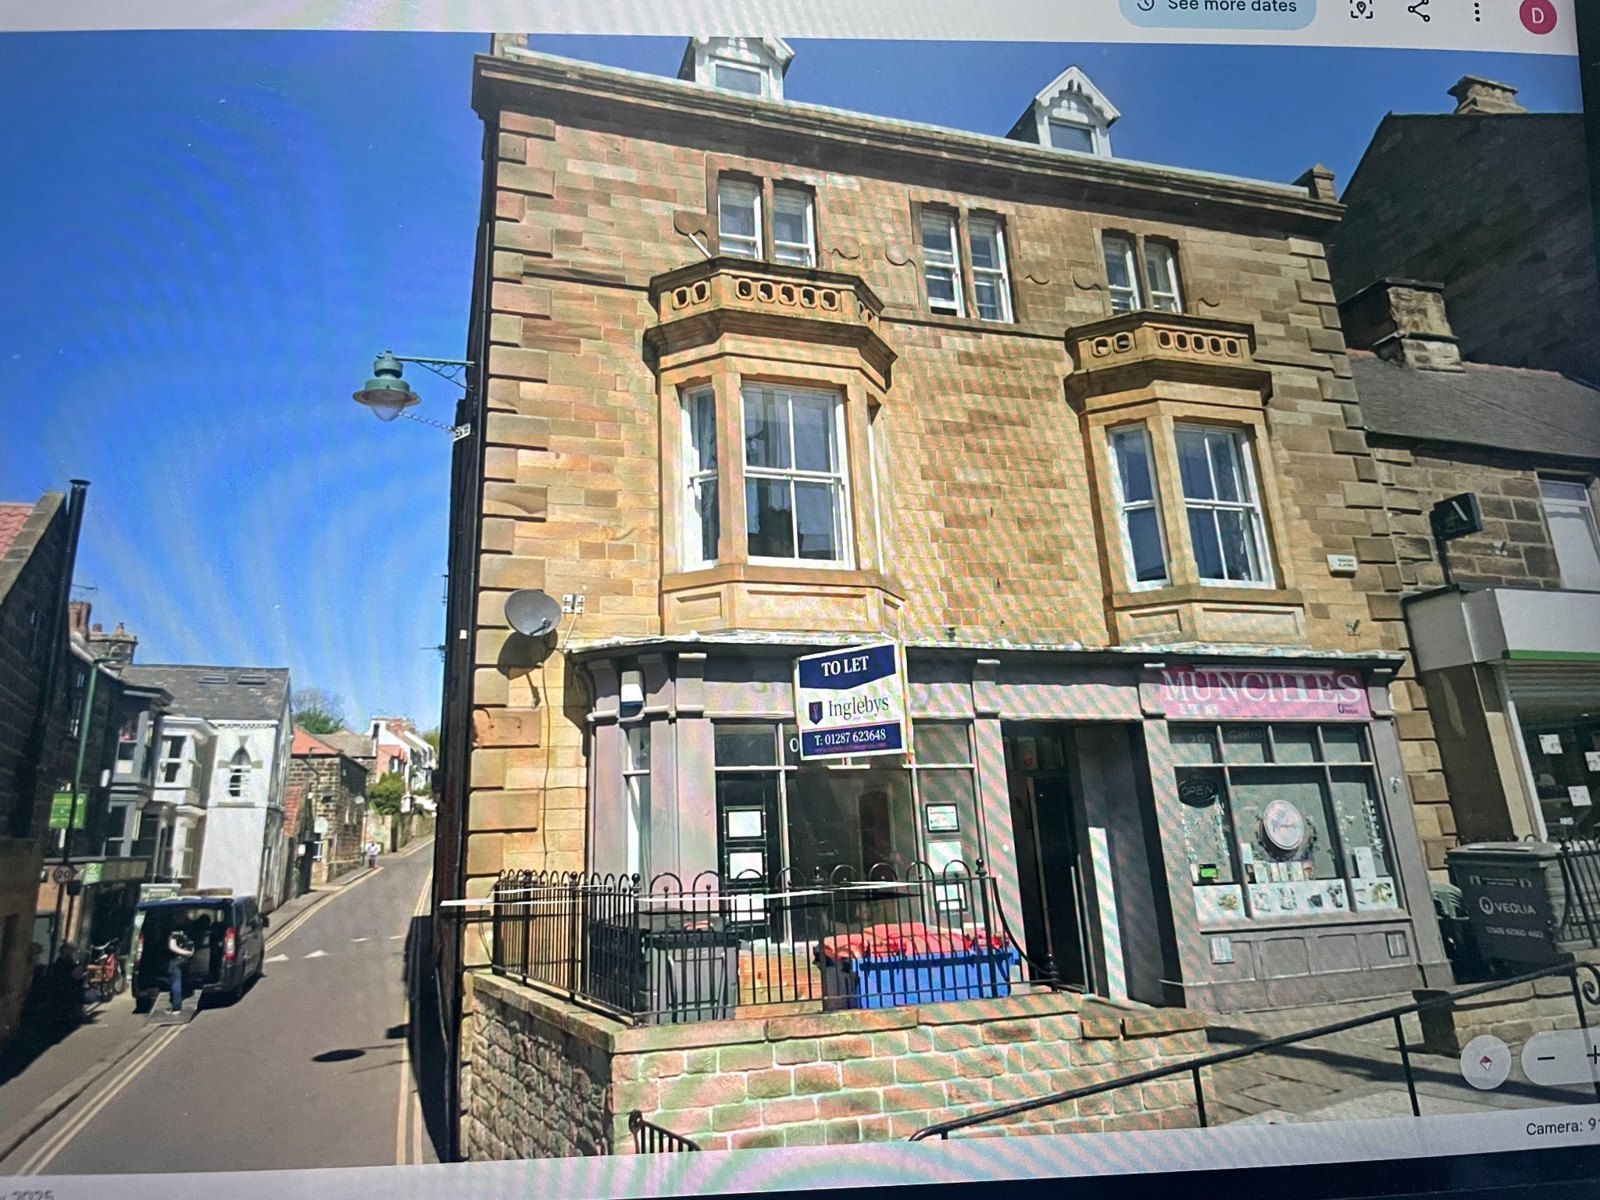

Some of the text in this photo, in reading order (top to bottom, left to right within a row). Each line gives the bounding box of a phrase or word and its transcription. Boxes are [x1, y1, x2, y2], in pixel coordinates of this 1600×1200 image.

[1168, 0, 1297, 12] See more dates
[1531, 7, 1545, 24] D
[821, 655, 870, 677] TO LET
[1161, 669, 1362, 703] MUNCHIES
[828, 695, 889, 720] Inglebys
[814, 728, 886, 746] T: 01287 623648
[1180, 784, 1214, 797] OPEN
[57, 870, 71, 879] 20
[1493, 902, 1537, 916] VEOLIA
[1526, 1121, 1583, 1136] Camera:
